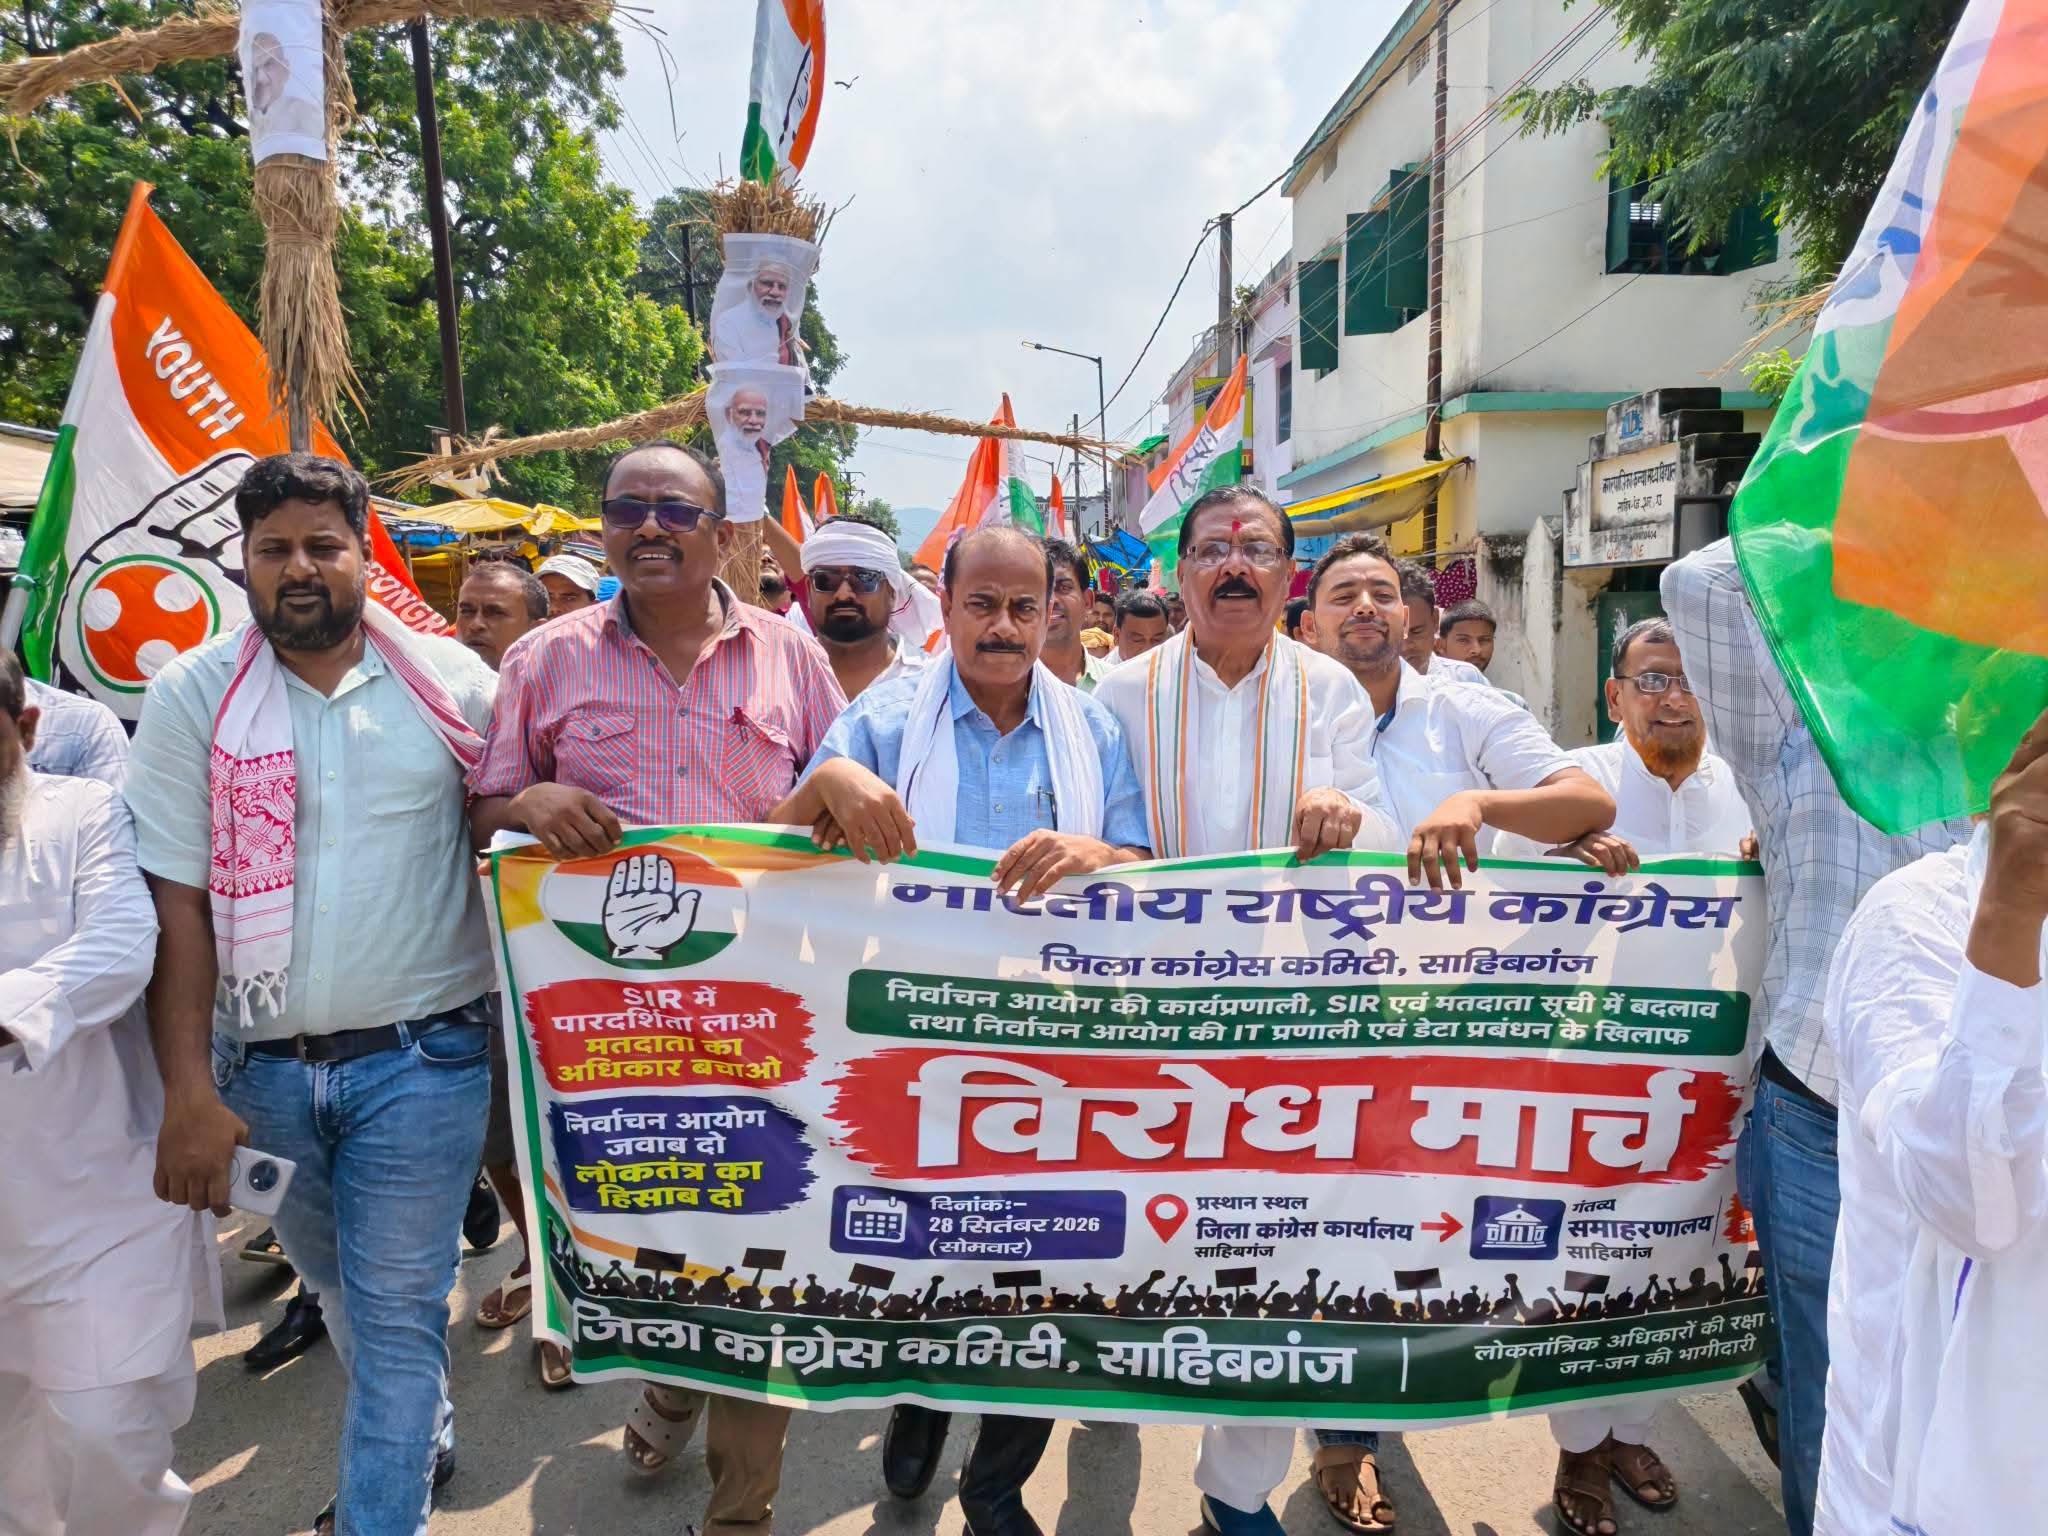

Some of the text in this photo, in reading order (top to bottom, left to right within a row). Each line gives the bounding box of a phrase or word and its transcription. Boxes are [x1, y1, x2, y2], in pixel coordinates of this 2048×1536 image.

[145, 316, 245, 440] YOUTH
[1227, 873, 1476, 941] राष्ट्रीय
[1488, 880, 1742, 933] कांग्रेस
[1040, 943, 1599, 981] जिला कांग्रेस कमिटी, साहिबगंज
[623, 986, 717, 1010] SIR में
[886, 978, 1002, 1009] निर्वाचन
[1007, 985, 1103, 1015] आयोग
[1110, 989, 1152, 1016] की
[1327, 995, 1379, 1014] SIR
[1388, 992, 1429, 1014] एवं
[1435, 995, 1532, 1014] मतदाता
[1540, 990, 1595, 1018] सूची
[1602, 991, 1625, 1015] में
[1629, 998, 1719, 1019] बदलाव
[552, 1008, 776, 1032] पारदर्शिता लाओ
[908, 1014, 1692, 1046] तथा निर्वाचन आयोग की IT प्रणाली एवं डेटा प्रबंधन के खिलाफ
[585, 1036, 742, 1056] मतदाता का
[558, 1056, 782, 1082] अधिकार बचाओ
[564, 1105, 766, 1134] निर्वाचन आयोग
[907, 1054, 1696, 1175] विरोध मार्च
[605, 1131, 726, 1156] जवाब दो
[575, 1156, 763, 1183] लोकतंत्र का
[598, 1184, 744, 1208] हिसाब दो
[1195, 1194, 1308, 1212] प्रस्थान स्थल
[1572, 1197, 1616, 1214] गंतव्य
[929, 1213, 1101, 1235] 28 सितंबर 2026
[1196, 1216, 1414, 1242] जिला कांग्रेस कार्यालय
[1568, 1213, 1714, 1240] समाहरणालय
[928, 1237, 1033, 1257] (सोमवार)
[1194, 1242, 1274, 1259] साहिबगंज
[1566, 1244, 1653, 1262] साहिबगंज
[573, 1301, 1358, 1386] जिला कांग्रेस कमिटी, साहिबगंज
[1474, 1335, 1601, 1360] लोकतांत्रिक
[1607, 1321, 1696, 1348] अधिकारों
[1702, 1315, 1728, 1335] की
[1730, 1312, 1766, 1331] रक्षा
[1559, 1334, 1757, 1376] जन-जन की भागीदारी
